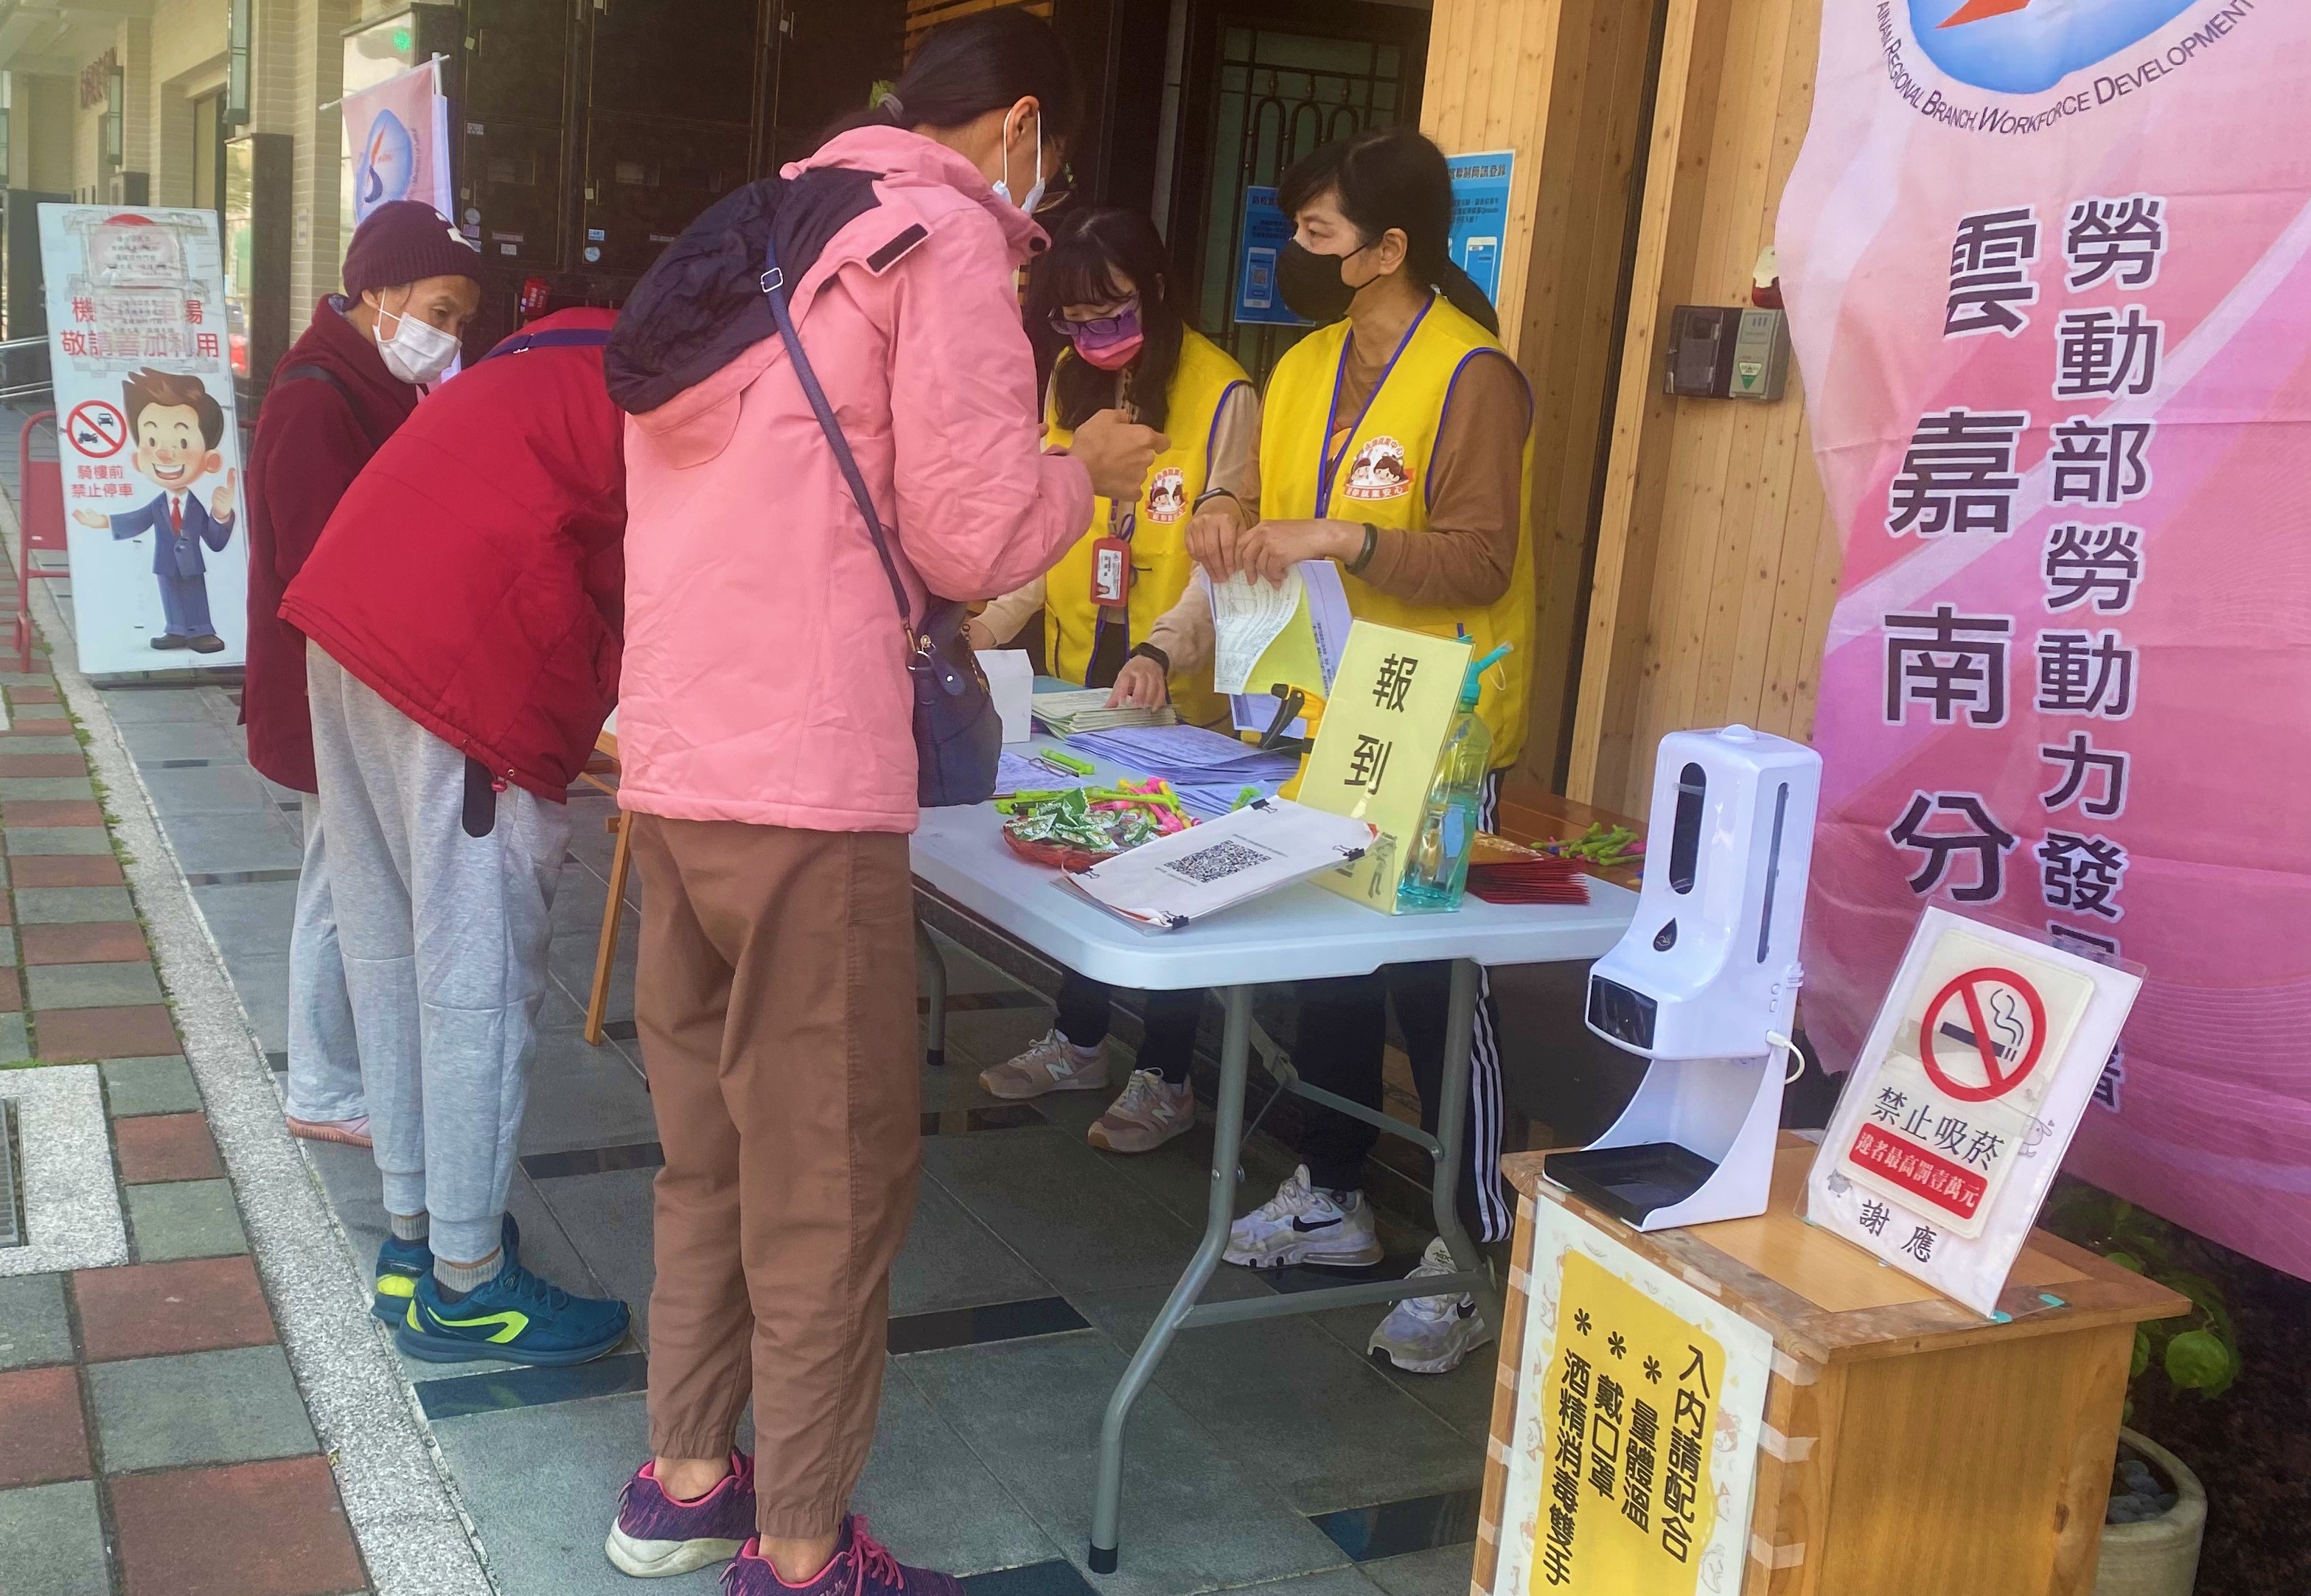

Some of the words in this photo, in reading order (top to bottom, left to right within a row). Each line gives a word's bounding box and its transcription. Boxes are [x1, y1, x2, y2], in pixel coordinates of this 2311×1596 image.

[1877, 0, 1893, 47] AINAN
[1884, 38, 1925, 108] REGIONAL
[1978, 91, 2091, 135] WORKFORCE
[60, 330, 220, 358] 敬請善加利用
[71, 483, 134, 498] 禁止停車
[77, 464, 124, 480] 騎樓前
[2037, 197, 2161, 1106] 勞動部勞動力發
[1343, 653, 1419, 796] 報到
[1869, 1087, 2005, 1171] 禁止吸菸
[1855, 1131, 1981, 1209] 違者最高罰壹萬元
[1542, 1348, 1592, 1586] 酒精消毒雙手
[1587, 1373, 1625, 1501] 戴口罩
[1621, 1397, 1661, 1535] 量體溫
[1661, 1344, 1711, 1564] 入內請配合
